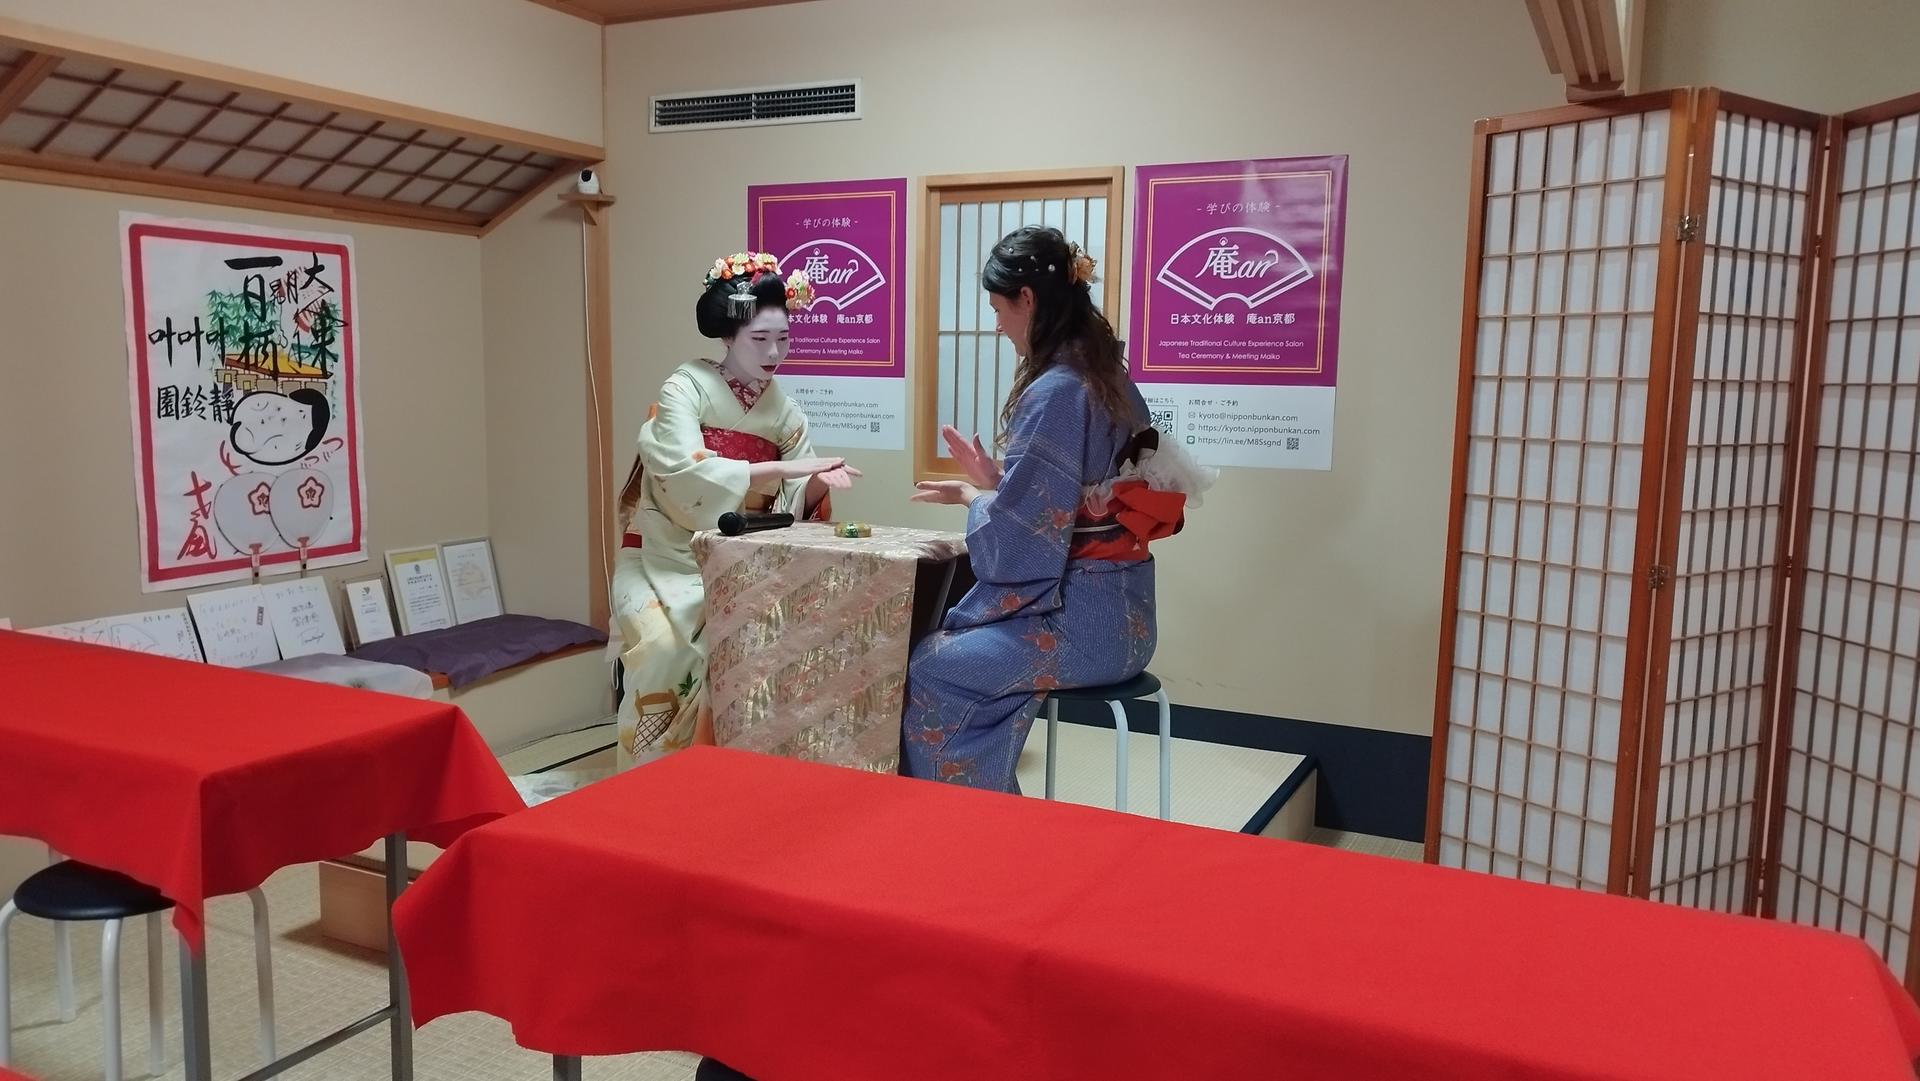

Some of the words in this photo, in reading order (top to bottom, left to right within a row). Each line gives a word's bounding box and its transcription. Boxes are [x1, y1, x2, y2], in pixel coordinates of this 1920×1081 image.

[1206, 202, 1271, 215] 学びの体験
[803, 217, 851, 229] 学びの体験
[788, 313, 828, 324] 本文化体験
[1170, 313, 1235, 325] 日本文化体験
[1159, 340, 1189, 348] Japanese
[1248, 340, 1285, 348] Experience
[1285, 340, 1304, 348] Salon
[796, 347, 821, 355] Ceremony
[827, 348, 848, 356] Meeting
[1178, 352, 1190, 360] Tea
[1191, 352, 1225, 361] Ceremony
[1231, 353, 1259, 361] Meeting
[1259, 353, 1281, 361] Maiko
[803, 399, 879, 408] kyoto@nipponbunkan.com
[1199, 411, 1299, 422] kyoto@nipponbunkan.com
[807, 421, 867, 430] ttps://lin.ee/M8Ssgnd
[1198, 423, 1321, 436] https://kyoto.nipponbunkan.com
[1198, 436, 1282, 448] https://lin.ee/M8Ssgnd
